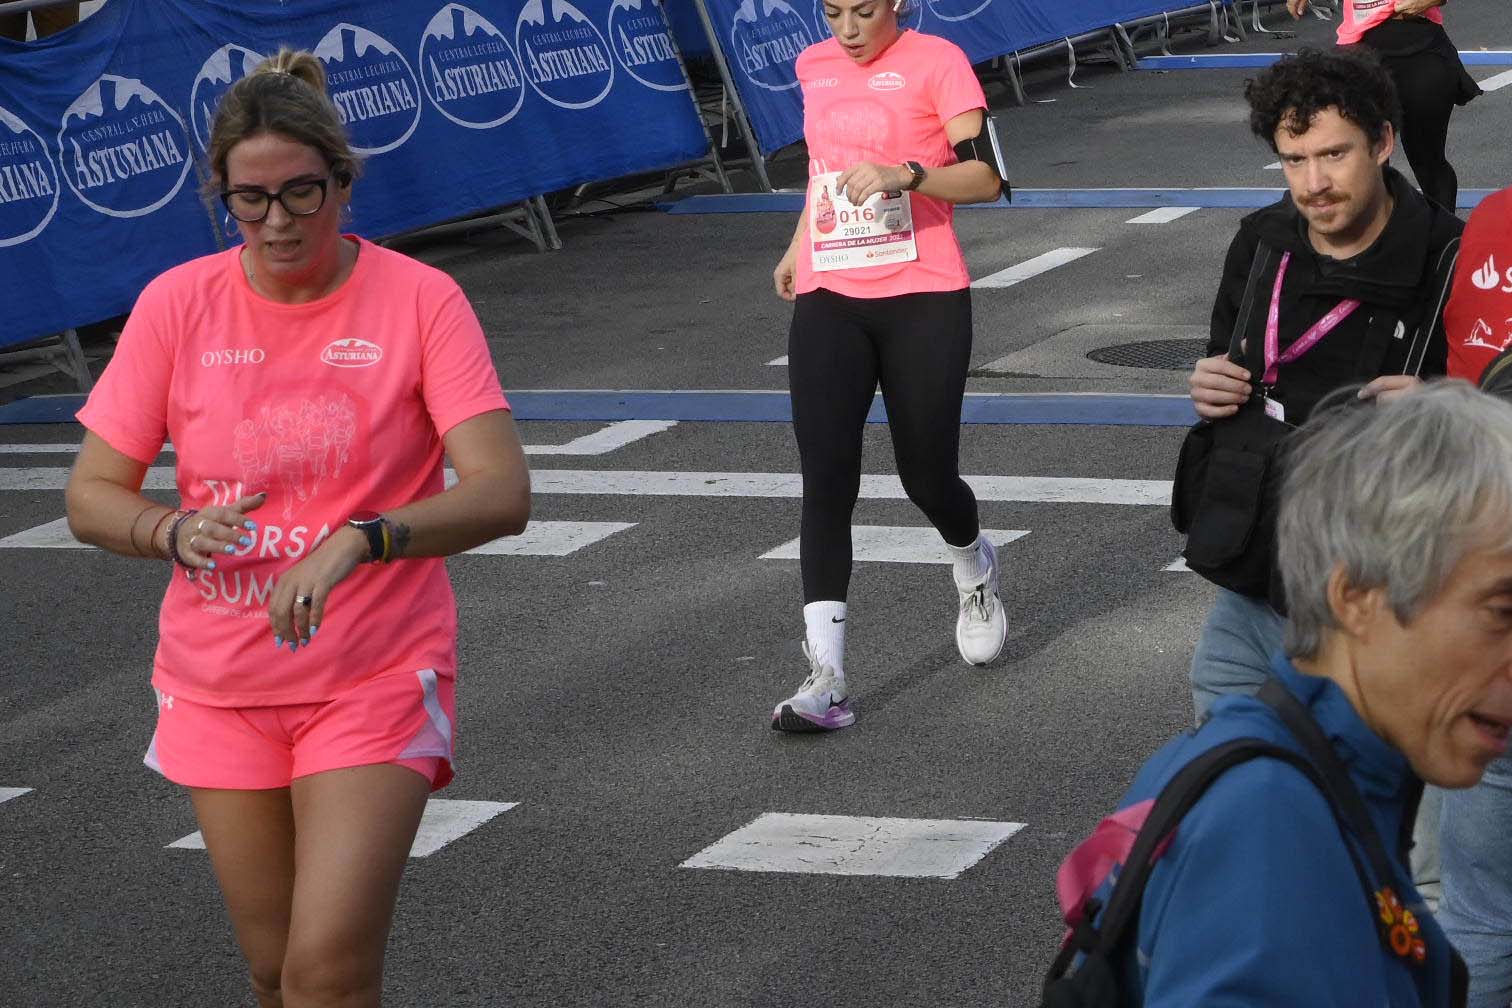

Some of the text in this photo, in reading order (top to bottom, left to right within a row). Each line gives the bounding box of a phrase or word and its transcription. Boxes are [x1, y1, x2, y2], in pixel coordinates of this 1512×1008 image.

[439, 46, 471, 62] CENTRAL
[524, 39, 610, 84] ASTURIANA
[327, 67, 364, 86] CENTRAL
[428, 54, 521, 102] ASTURIANA
[332, 78, 417, 125] STURIANA
[839, 207, 875, 223] 016
[844, 225, 872, 236] 29021
[820, 239, 848, 250] CARRERA
[847, 238, 857, 248] DE
[857, 237, 866, 246] LA
[201, 348, 265, 368] OYSHO
[326, 349, 380, 363] ASTURIANA
[200, 569, 274, 607] SUM
